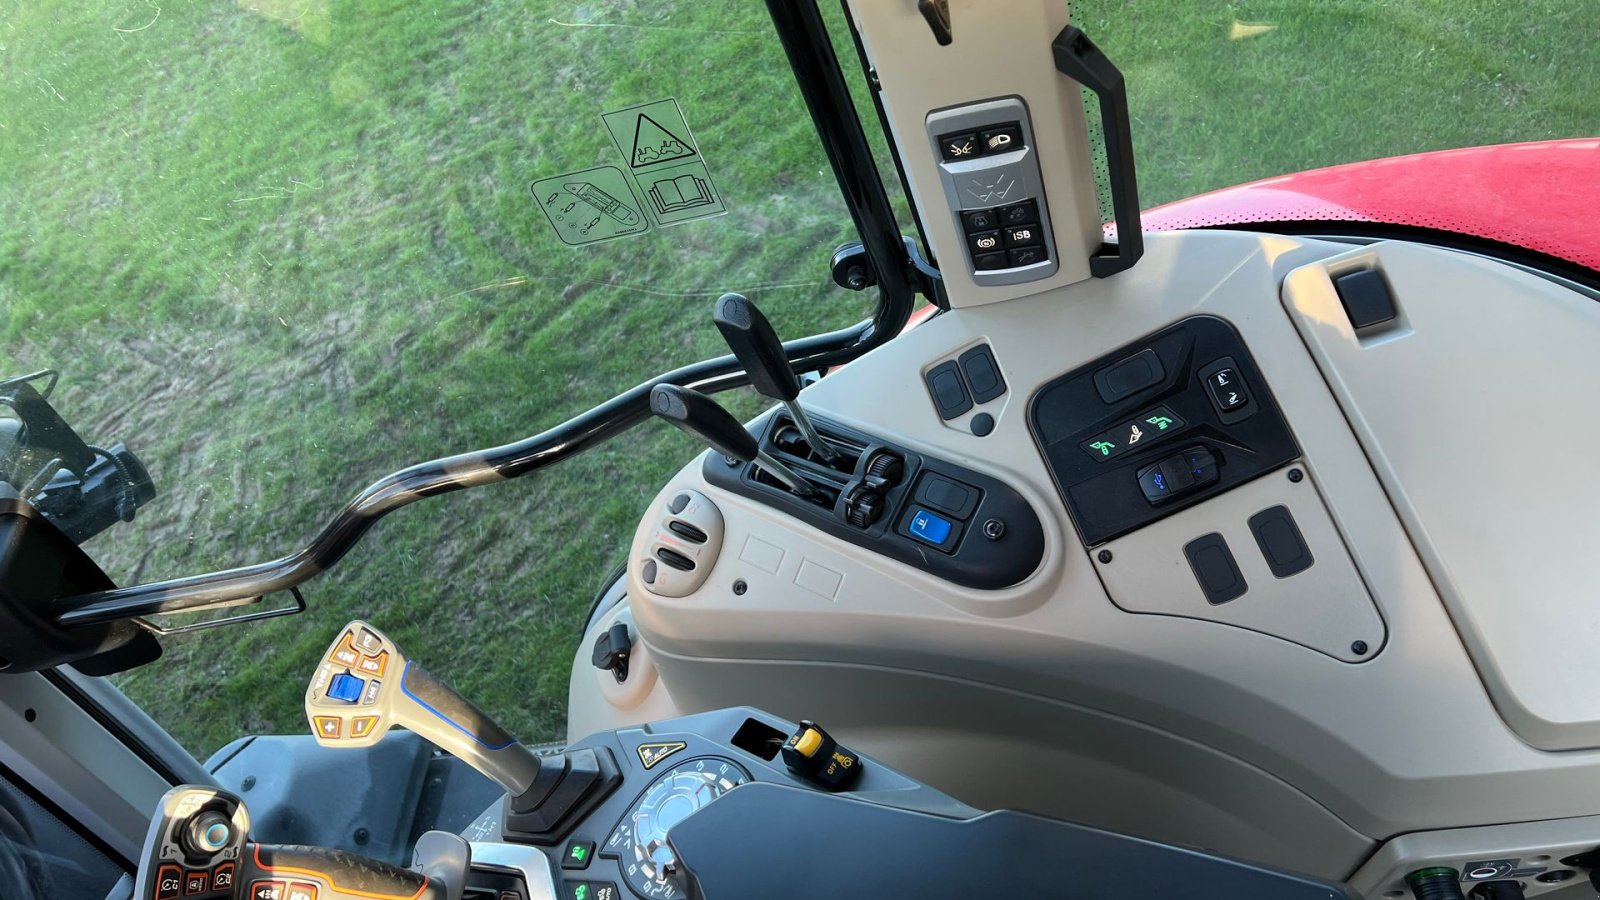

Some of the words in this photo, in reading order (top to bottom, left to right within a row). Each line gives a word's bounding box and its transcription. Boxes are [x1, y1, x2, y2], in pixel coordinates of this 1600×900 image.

[1013, 230, 1031, 241] ISB
[790, 735, 800, 745] ON
[827, 762, 837, 775] OFF
